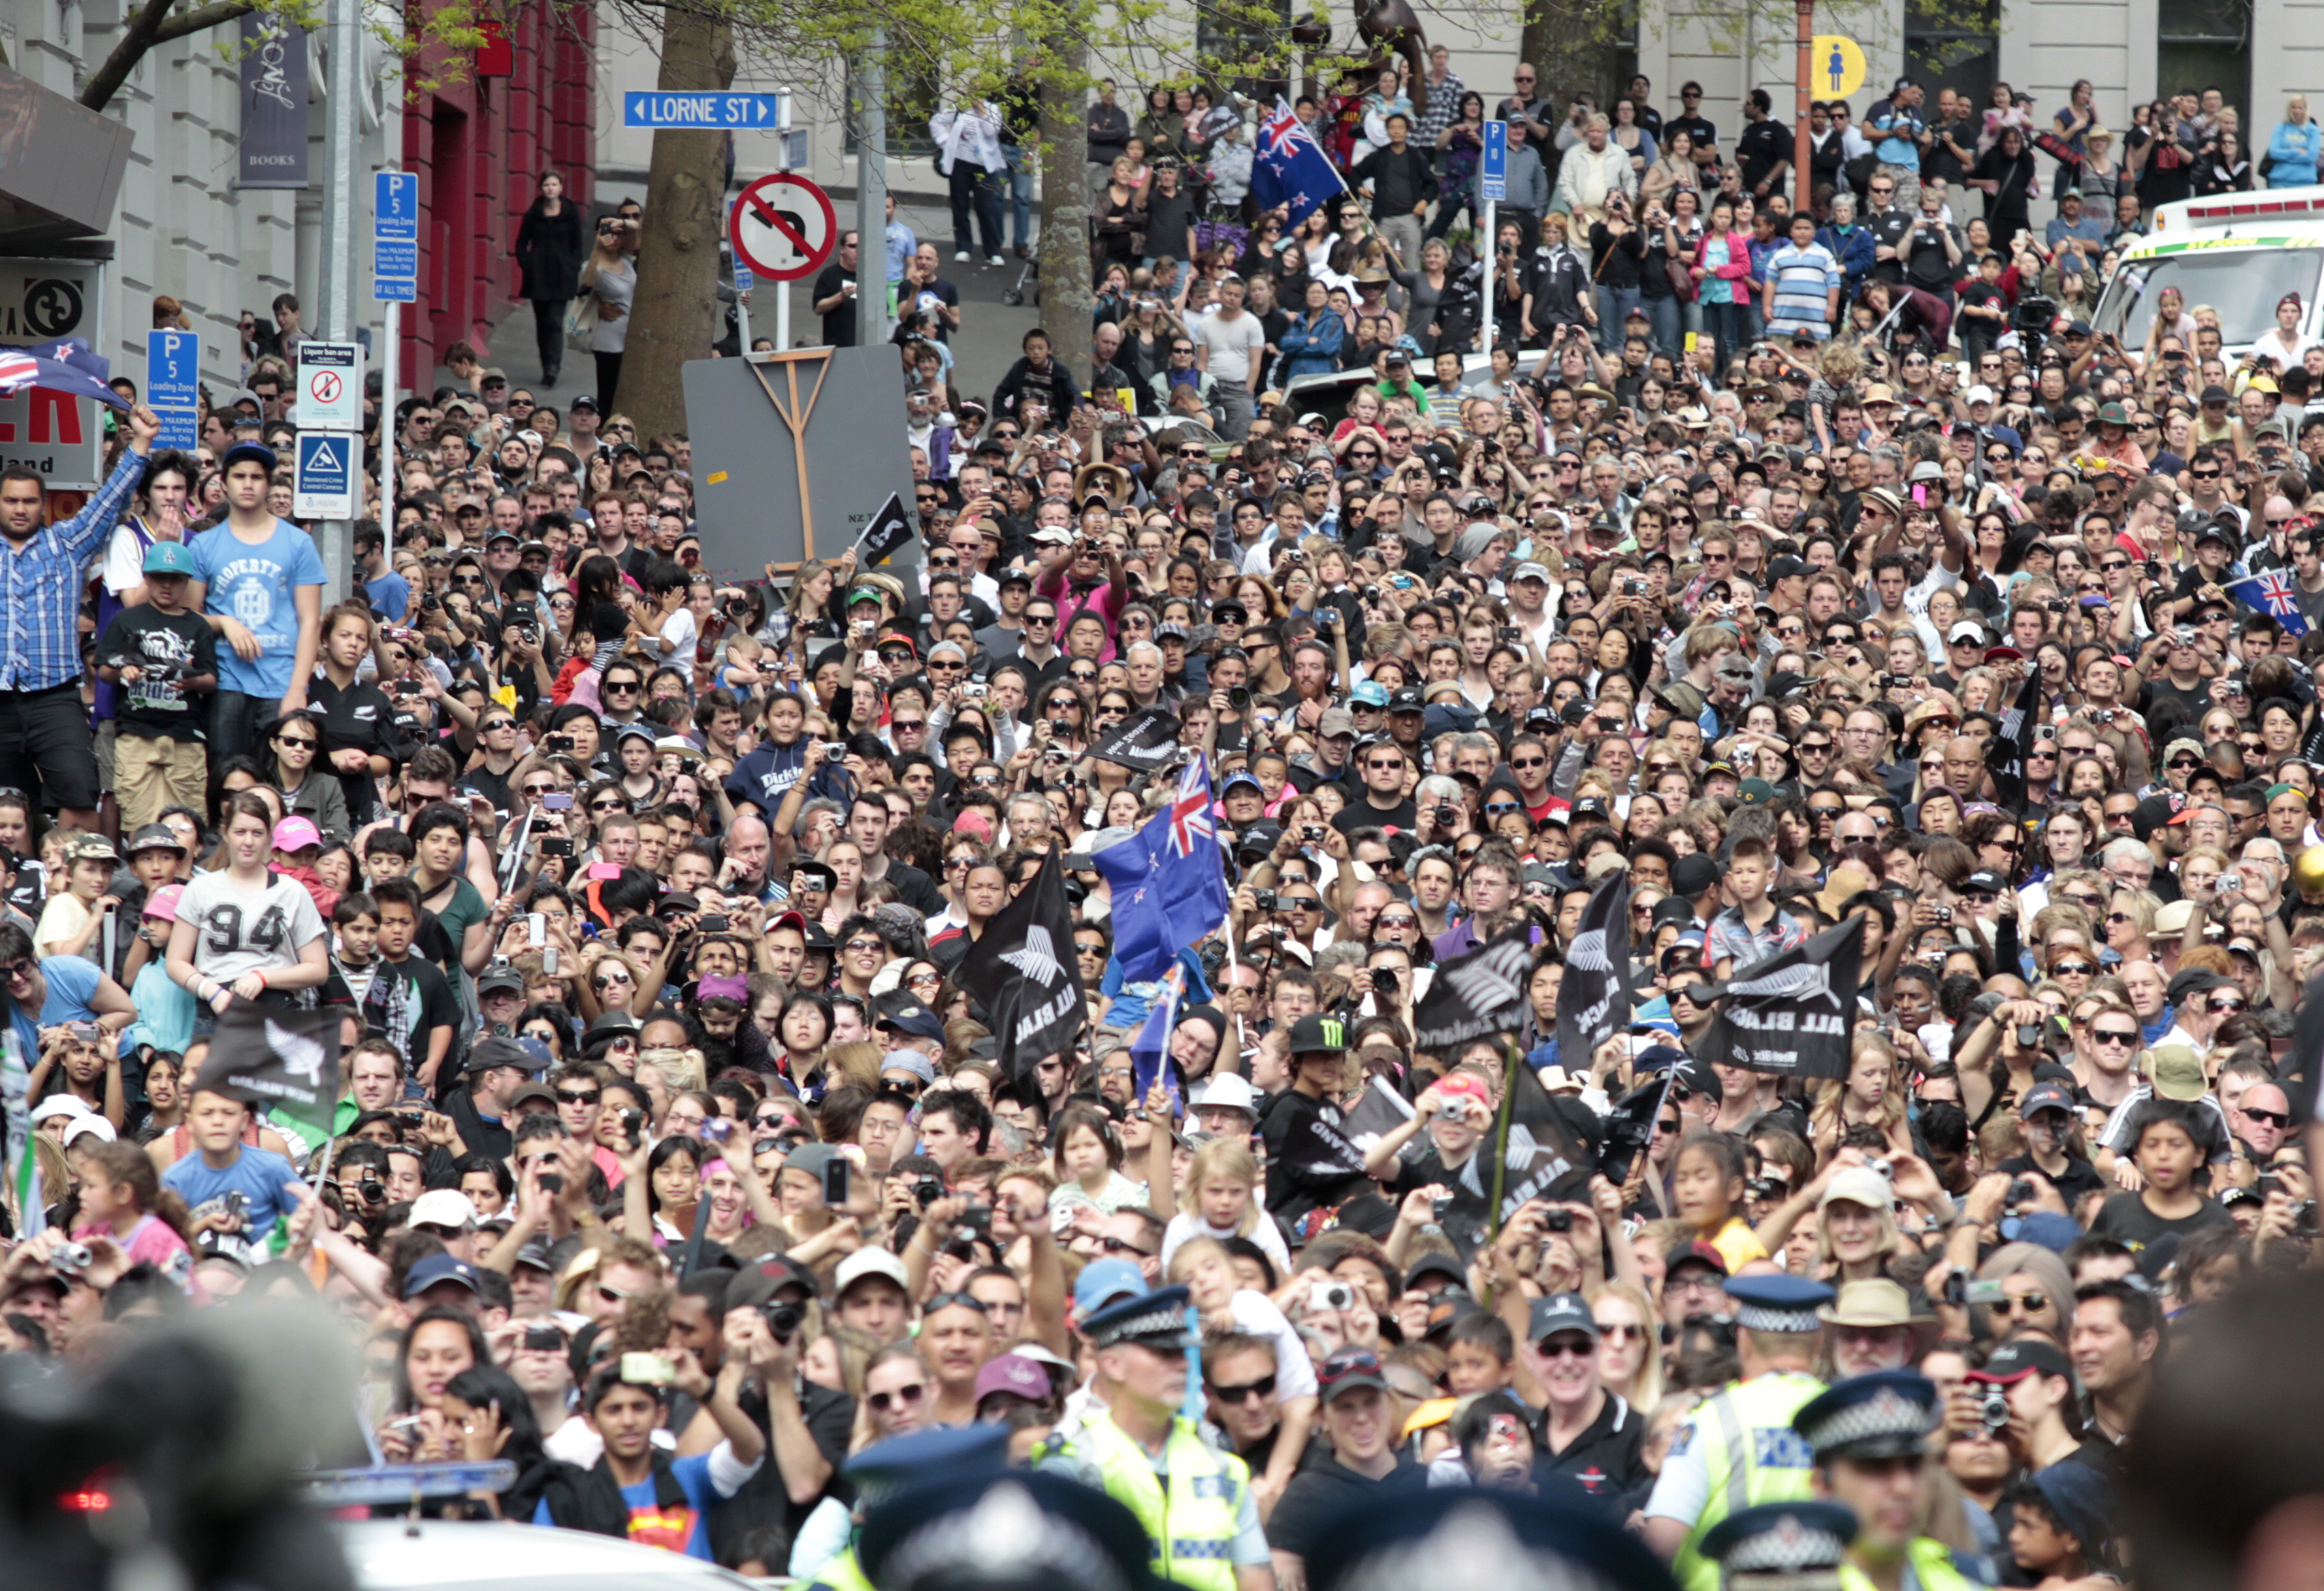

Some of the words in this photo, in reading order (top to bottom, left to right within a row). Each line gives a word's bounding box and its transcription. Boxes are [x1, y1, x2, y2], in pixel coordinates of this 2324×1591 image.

[651, 97, 717, 122] LORNE
[725, 99, 750, 123] ST
[1491, 123, 1500, 139] P
[250, 155, 295, 166] BOOKS
[389, 176, 404, 197] P
[392, 198, 401, 214] 5
[377, 216, 398, 227] Loading
[400, 217, 415, 226] Zone
[384, 285, 395, 295] ALL
[396, 286, 414, 295] TIMES
[0, 307, 17, 335] A
[165, 335, 181, 358] P
[304, 347, 323, 357] Liquor
[168, 361, 177, 378] 5
[150, 381, 176, 393] Loading
[178, 383, 195, 392] Zone
[178, 435, 192, 443] Only
[848, 514, 863, 522] NZ
[214, 558, 282, 596] PROPERTY
[206, 902, 285, 952] 94
[1310, 1121, 1368, 1172] EALAND
